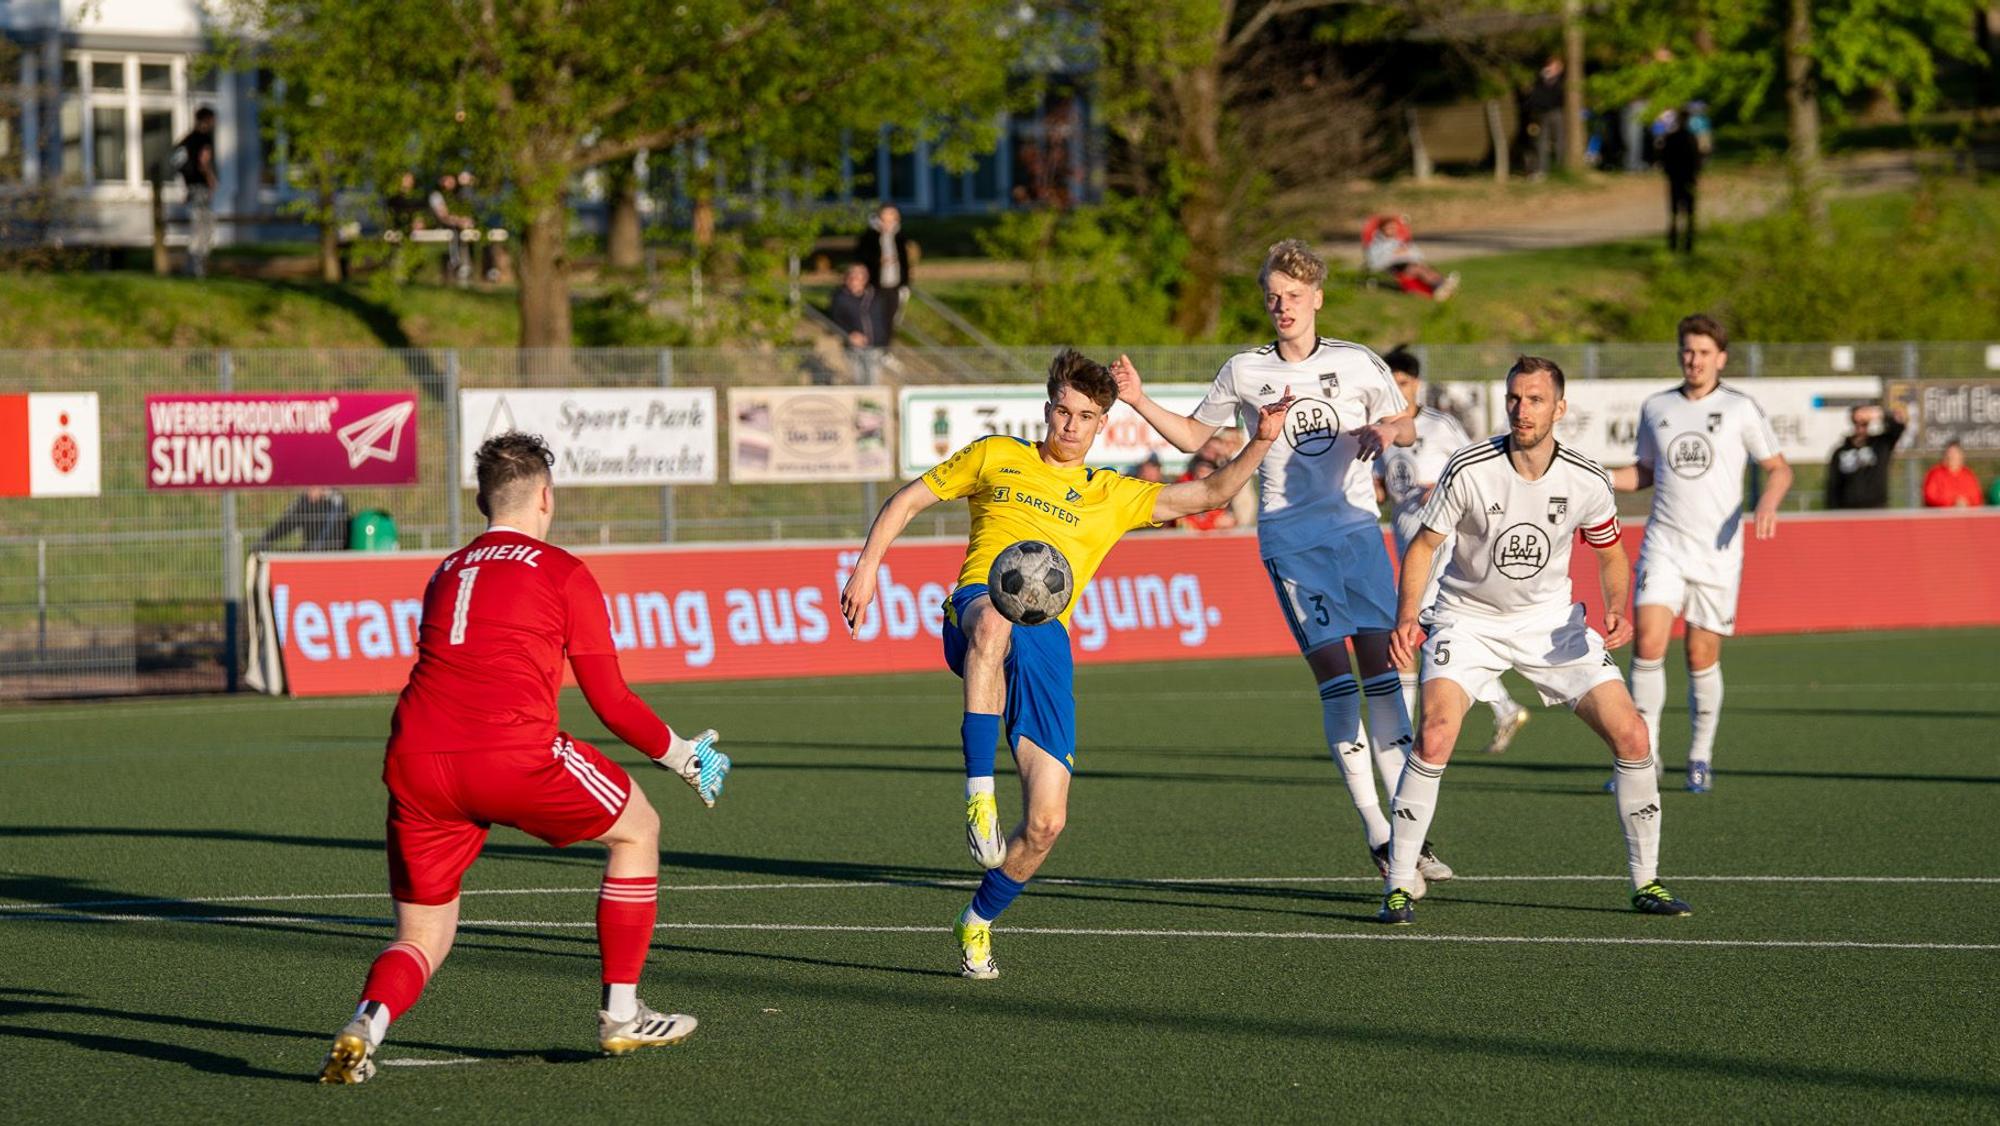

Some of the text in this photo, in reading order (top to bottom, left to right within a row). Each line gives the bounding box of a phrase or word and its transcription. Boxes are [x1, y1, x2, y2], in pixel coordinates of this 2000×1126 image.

[1924, 385, 1969, 423] Fünf
[151, 435, 273, 485] SIMONS
[1015, 491, 1081, 528] SARSTEDT
[464, 544, 543, 569] WIEHL
[449, 566, 480, 646] 1
[724, 586, 830, 647] aus
[1308, 594, 1331, 627] 3
[1433, 639, 1451, 666] 5
